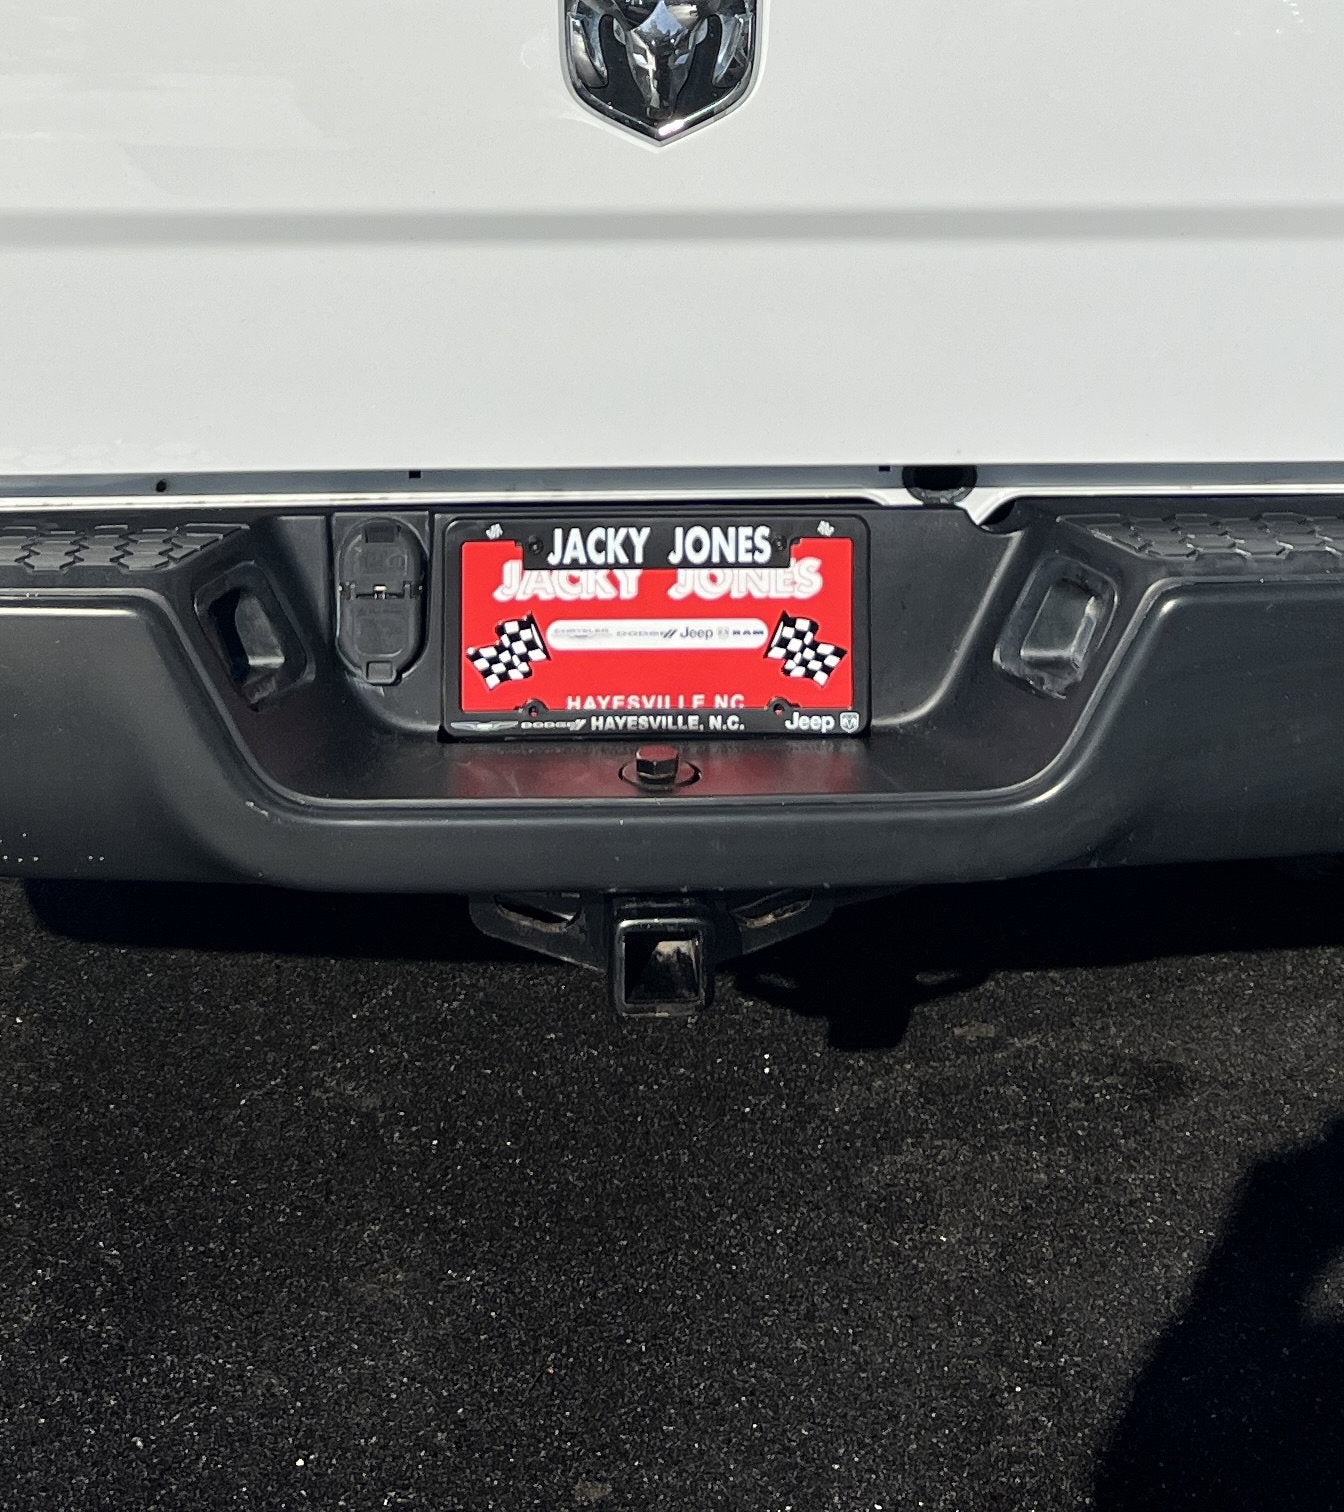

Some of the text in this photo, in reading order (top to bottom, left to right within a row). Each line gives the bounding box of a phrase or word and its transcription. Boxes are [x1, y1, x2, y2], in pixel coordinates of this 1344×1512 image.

[546, 525, 772, 566] JACKY JONES
[493, 557, 823, 601] JACKY JONES
[679, 626, 714, 639] Jeep
[590, 714, 704, 732] HAYESVILLE,
[709, 714, 745, 731] N.C.
[784, 713, 835, 733] Jeep
